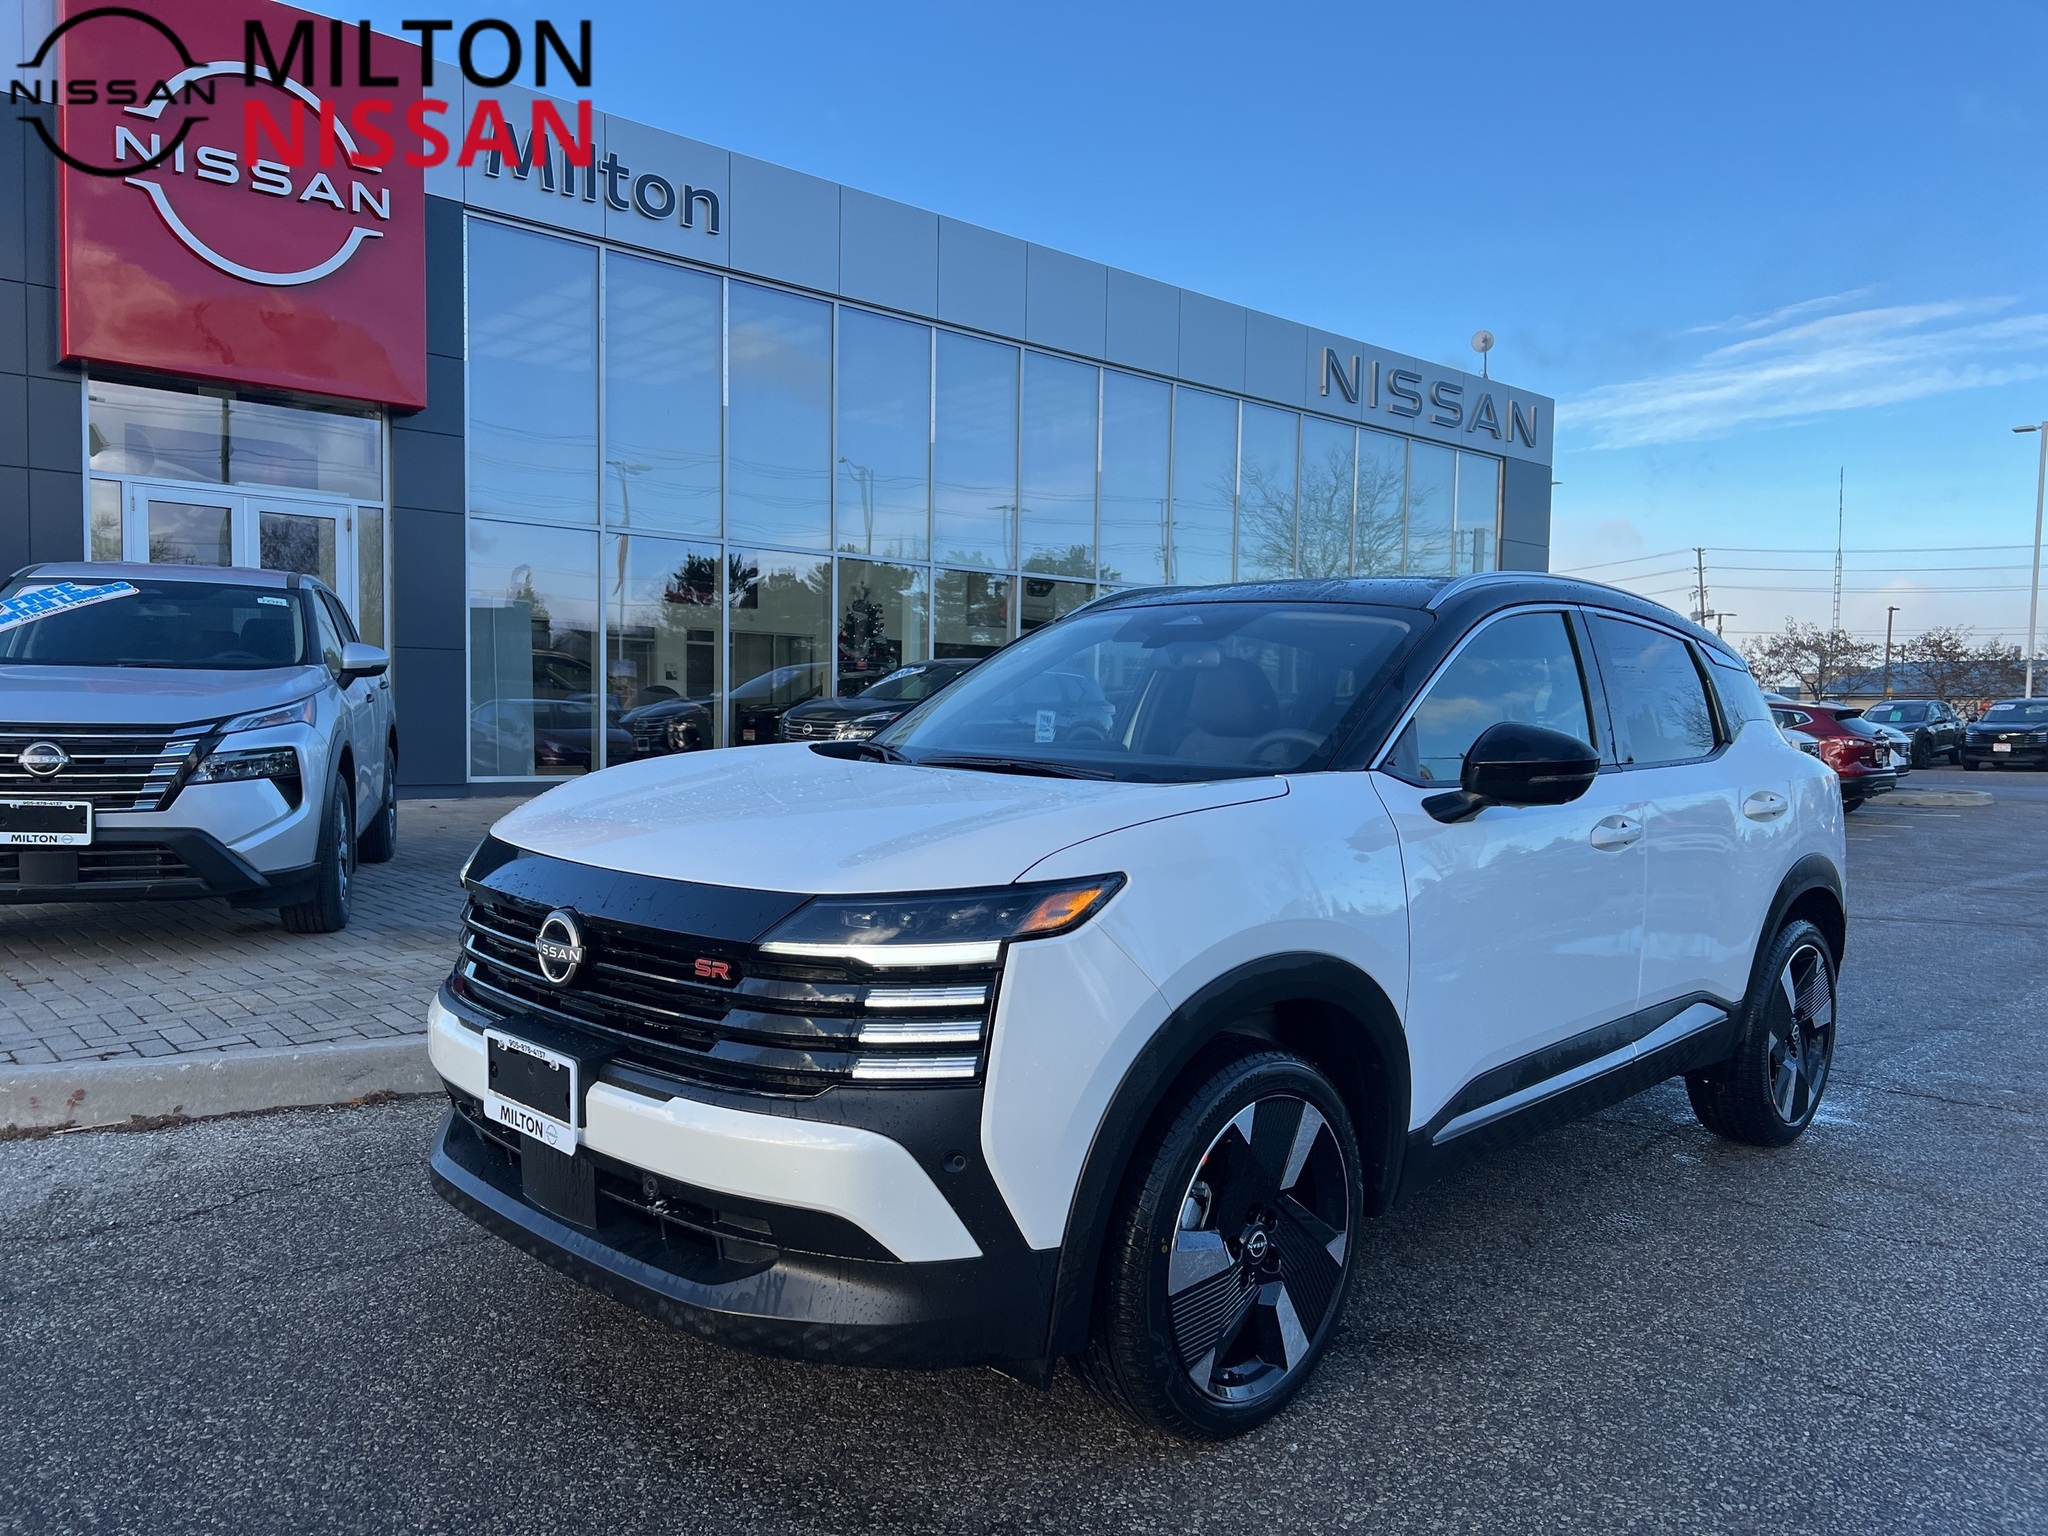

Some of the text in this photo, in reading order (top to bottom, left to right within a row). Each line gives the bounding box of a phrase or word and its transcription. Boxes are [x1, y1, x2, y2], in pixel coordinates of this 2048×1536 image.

[115, 125, 391, 219] NISSAN
[485, 121, 721, 234] Milton
[1320, 347, 1537, 447] NISSAN
[4, 582, 82, 610] FREE
[11, 834, 58, 843] MILTON
[695, 958, 731, 980] SR
[501, 1105, 543, 1138] MILTON
